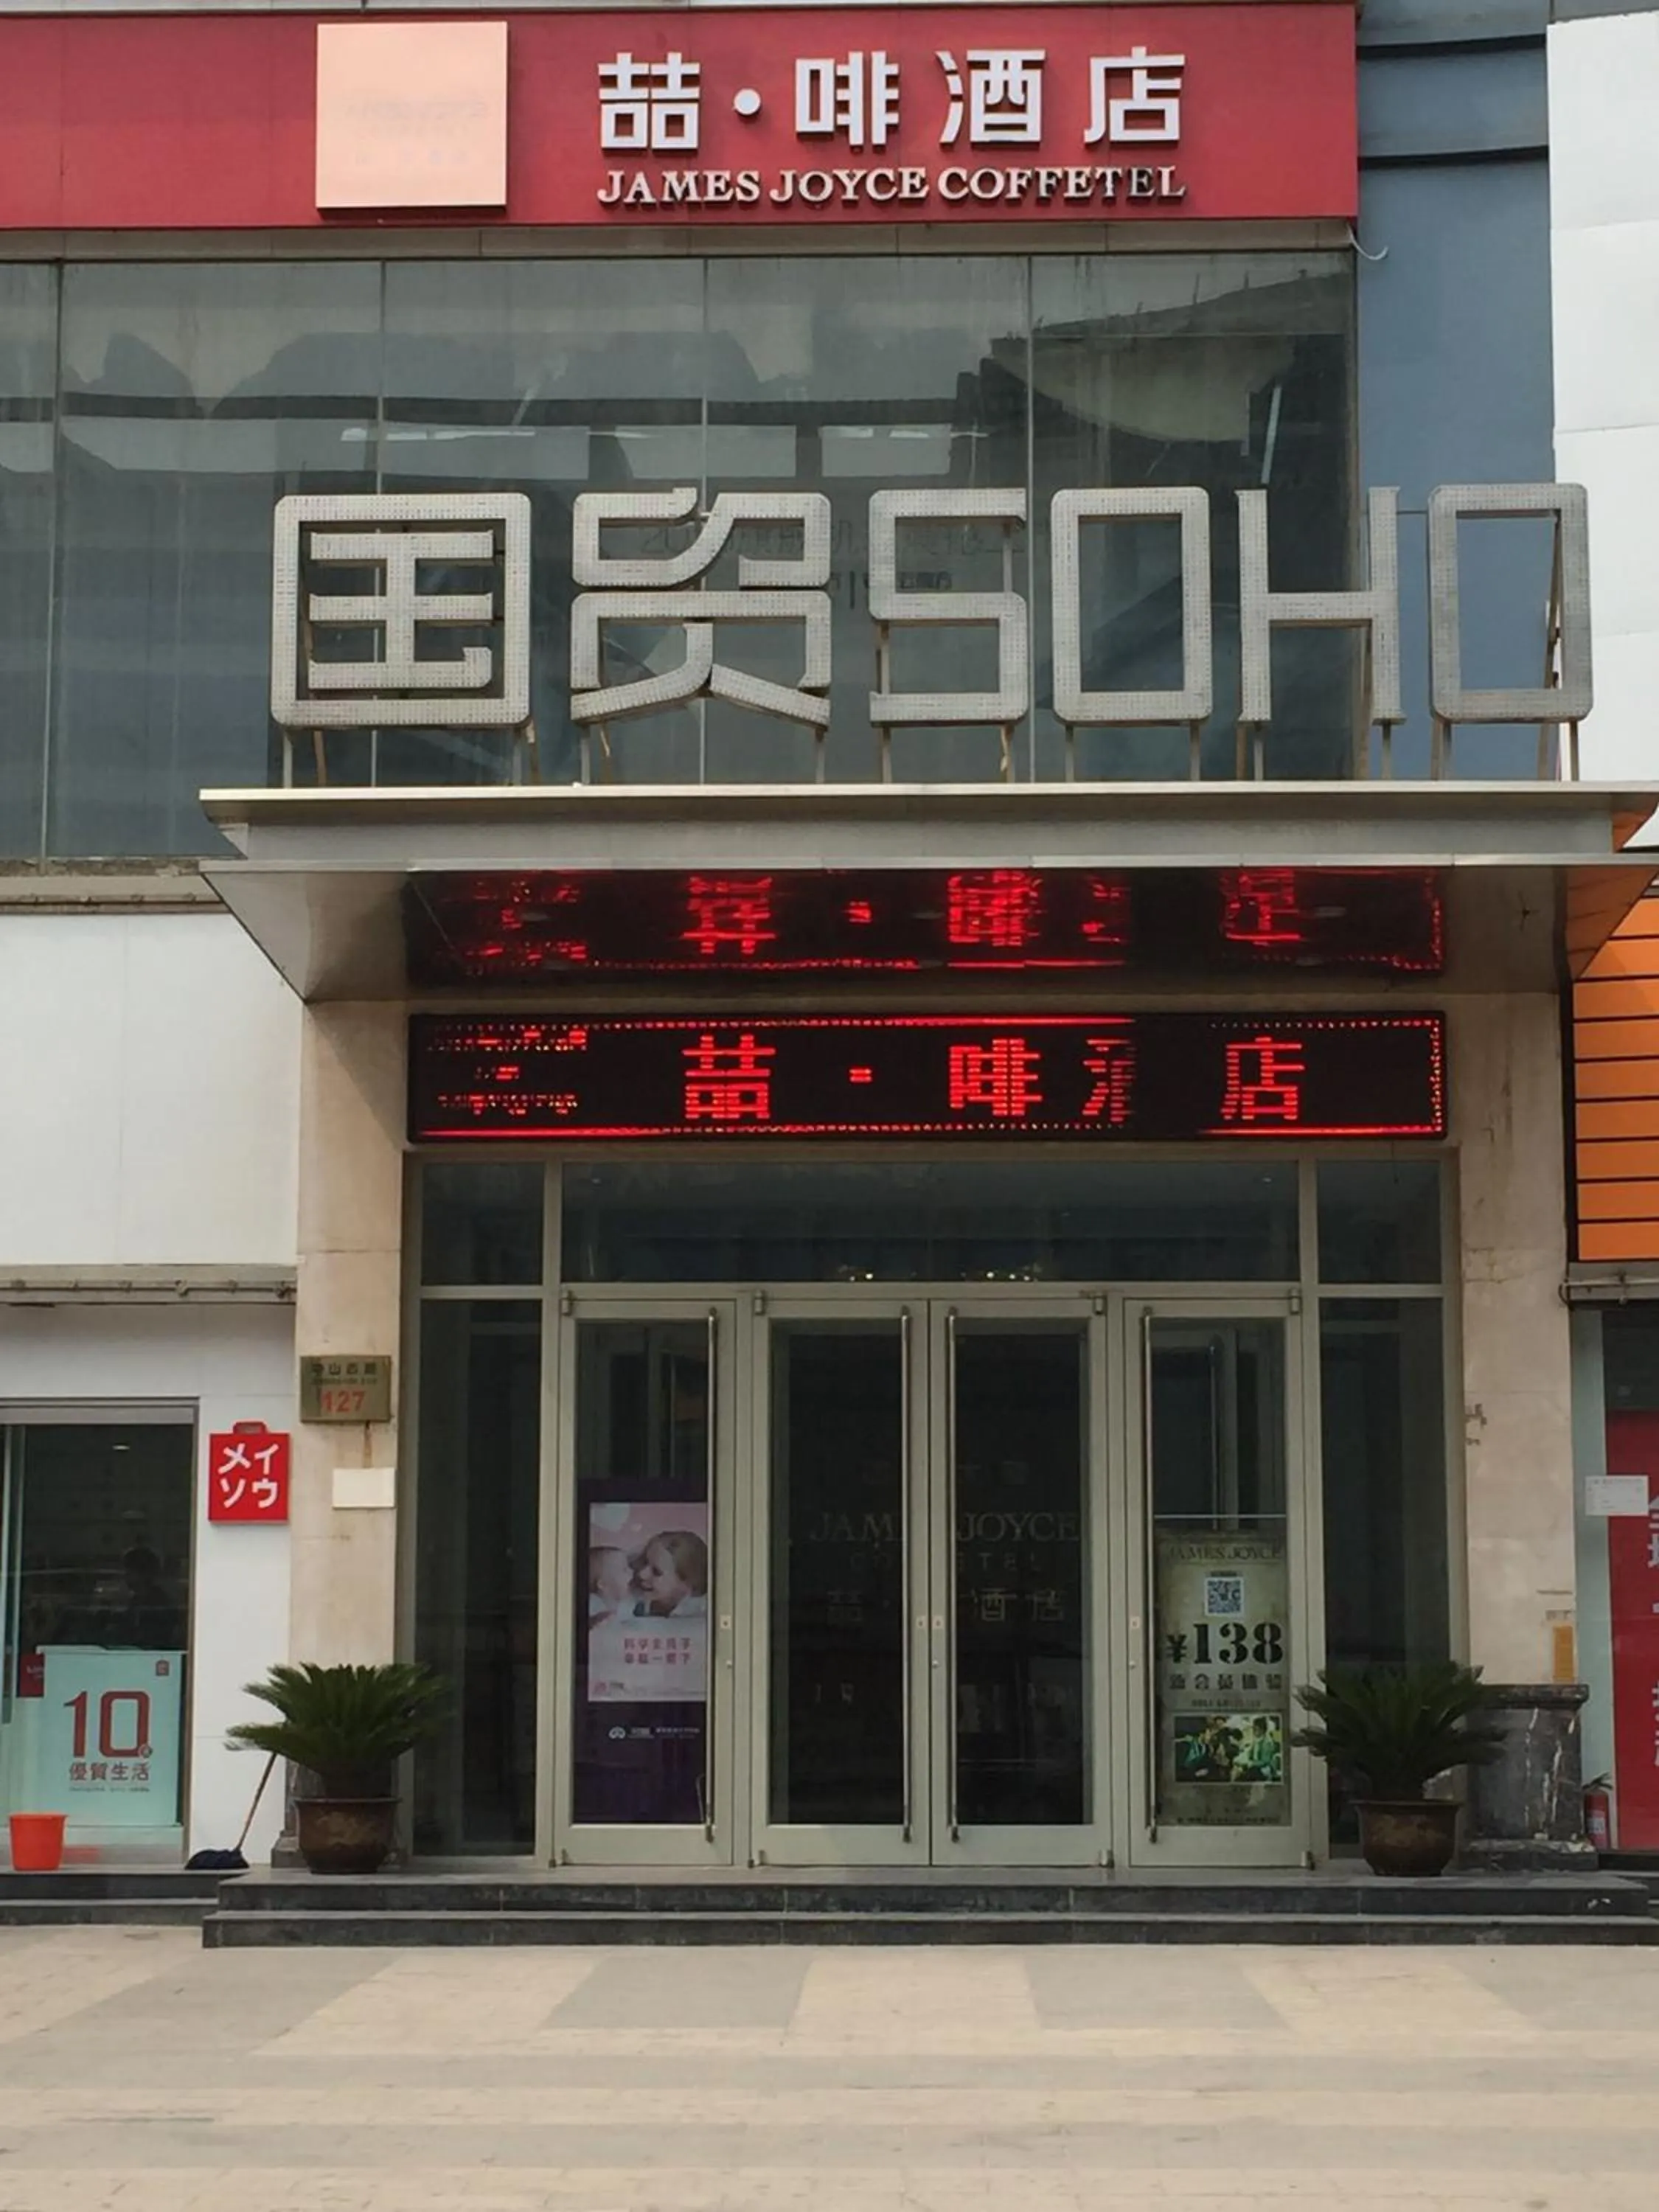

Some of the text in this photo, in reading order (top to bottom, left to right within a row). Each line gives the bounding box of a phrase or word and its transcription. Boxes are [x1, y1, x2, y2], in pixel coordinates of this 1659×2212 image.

[599, 46, 1186, 149] 喆·啡酒店
[597, 165, 1186, 204] JAMES JOYCE COFFETEL
[321, 1390, 366, 1413] 127
[218, 1443, 279, 1475] メイ
[219, 1478, 278, 1509] ソウ
[810, 1512, 1080, 1543] JAM JOYCE
